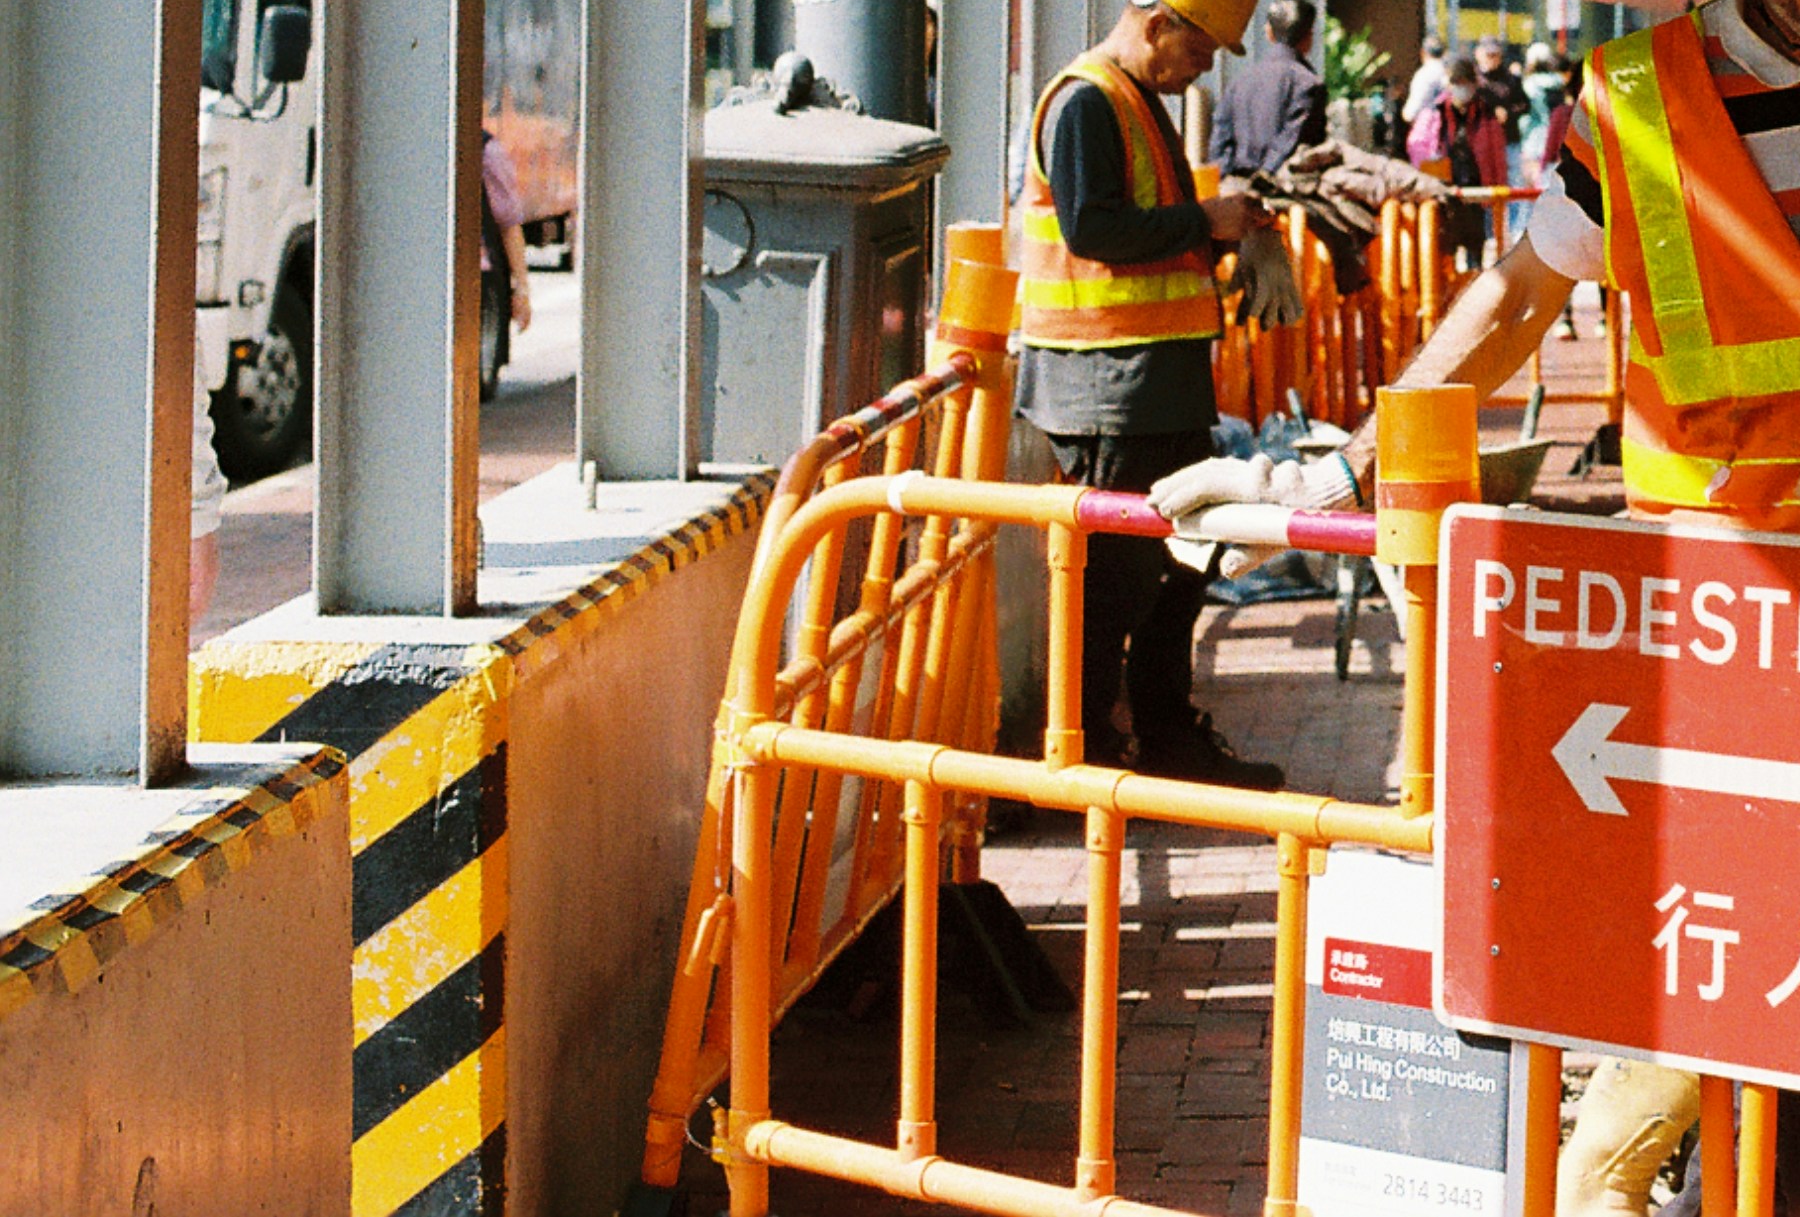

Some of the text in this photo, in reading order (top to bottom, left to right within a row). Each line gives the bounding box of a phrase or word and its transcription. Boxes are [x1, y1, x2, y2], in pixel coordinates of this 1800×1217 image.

[1329, 968, 1384, 988] Contractor
[1326, 1046, 1497, 1094] Pui Hing Construction
[1361, 1078, 1392, 1102] Ltd.
[1382, 1173, 1430, 1200] 2814
[1436, 1183, 1485, 1211] 3443
